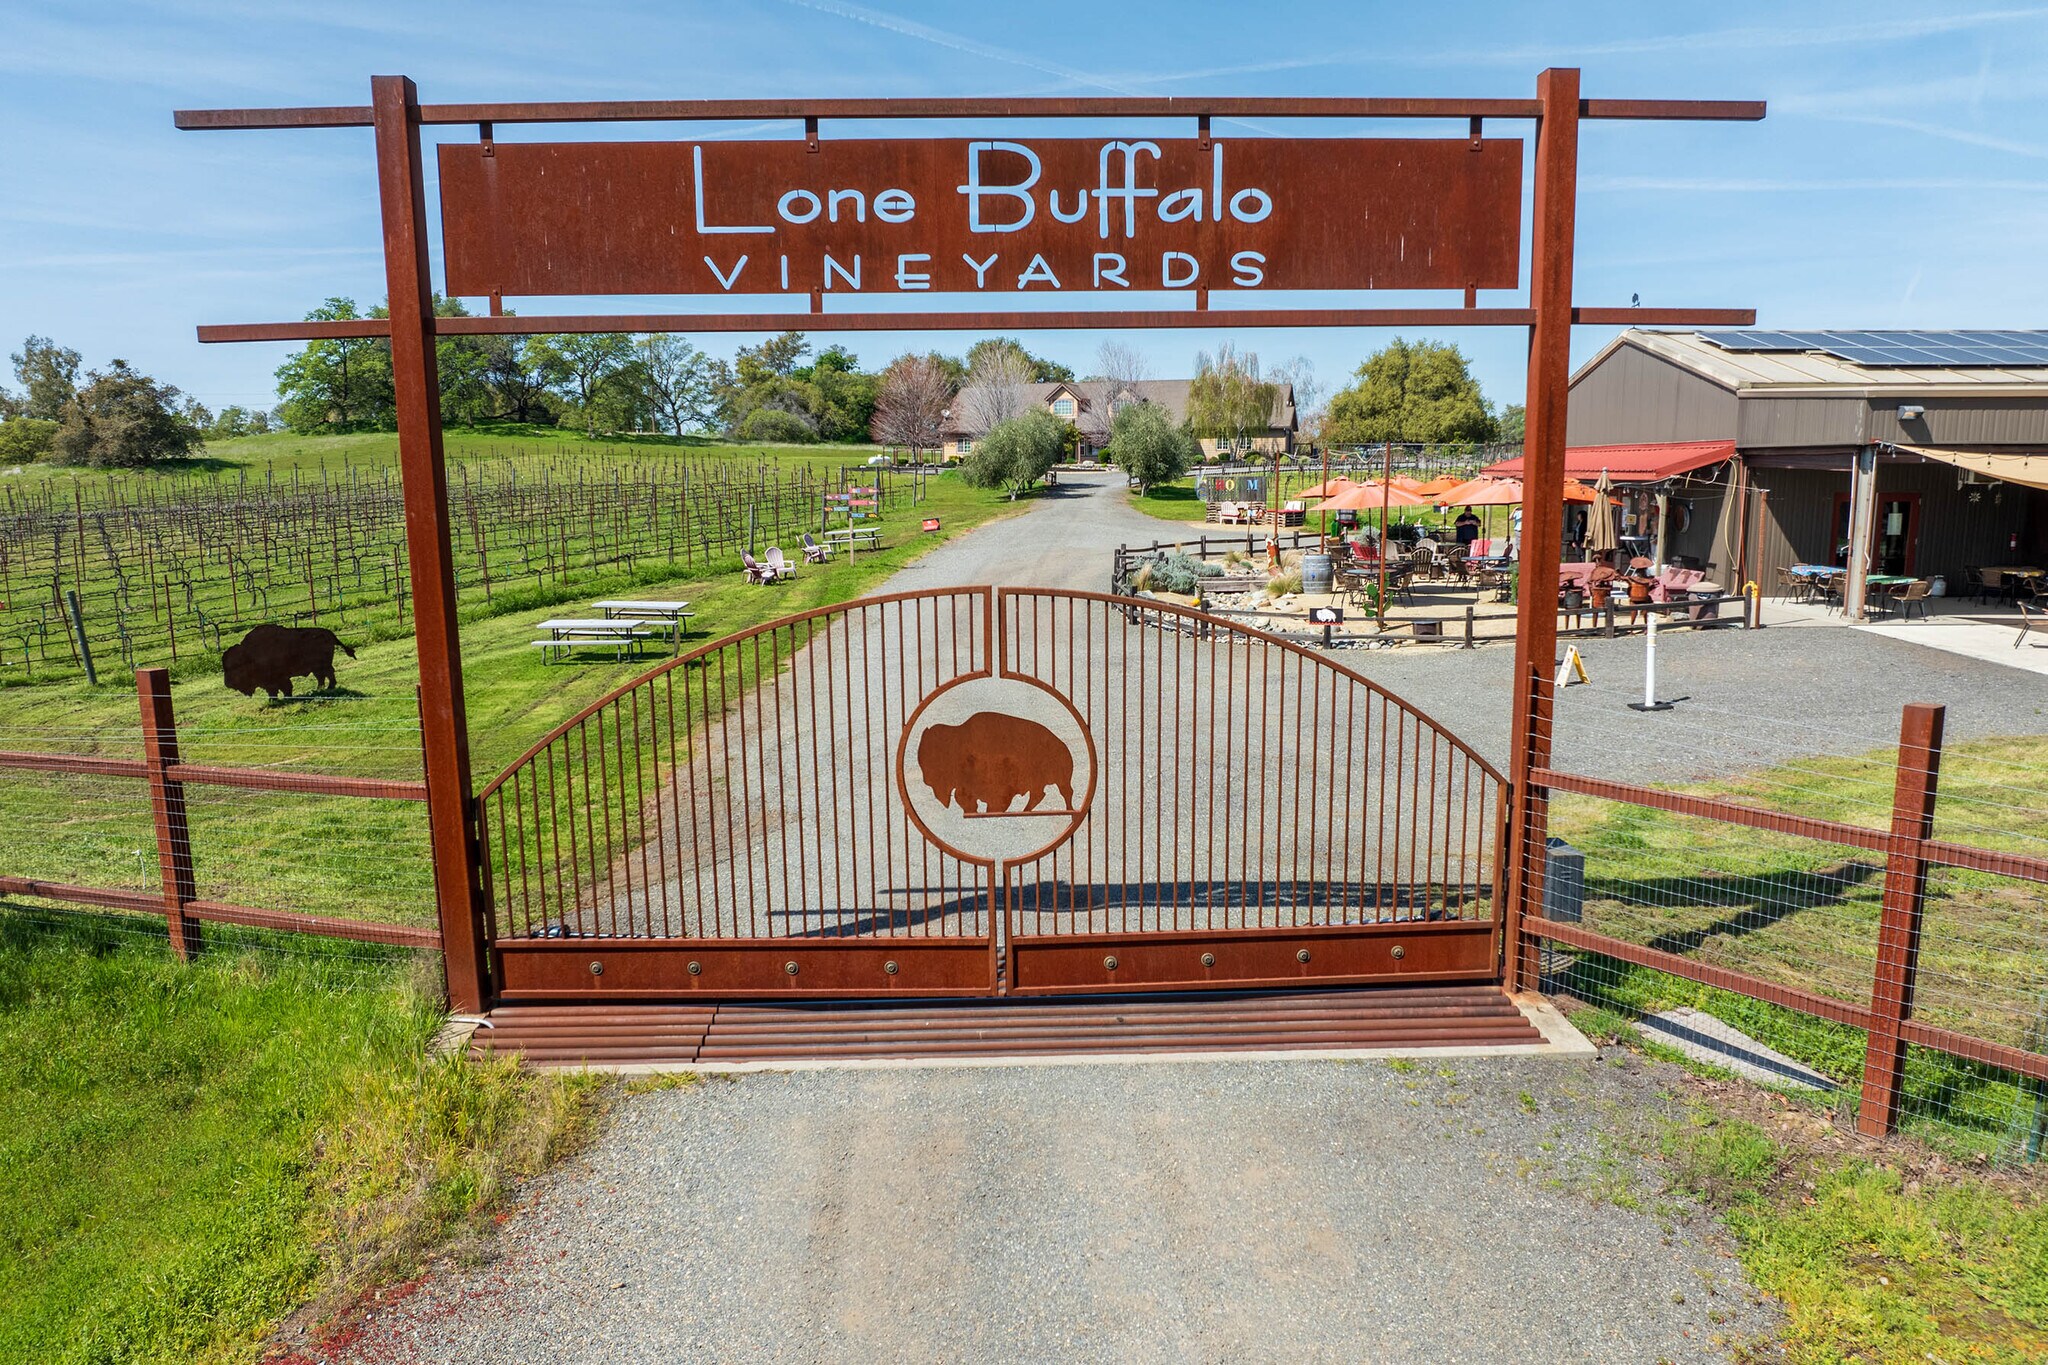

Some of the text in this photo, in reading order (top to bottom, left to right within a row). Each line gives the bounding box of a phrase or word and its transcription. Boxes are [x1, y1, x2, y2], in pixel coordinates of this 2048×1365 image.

[693, 140, 1273, 239] Lone Buffalo
[703, 251, 1266, 290] VINEYARDS
